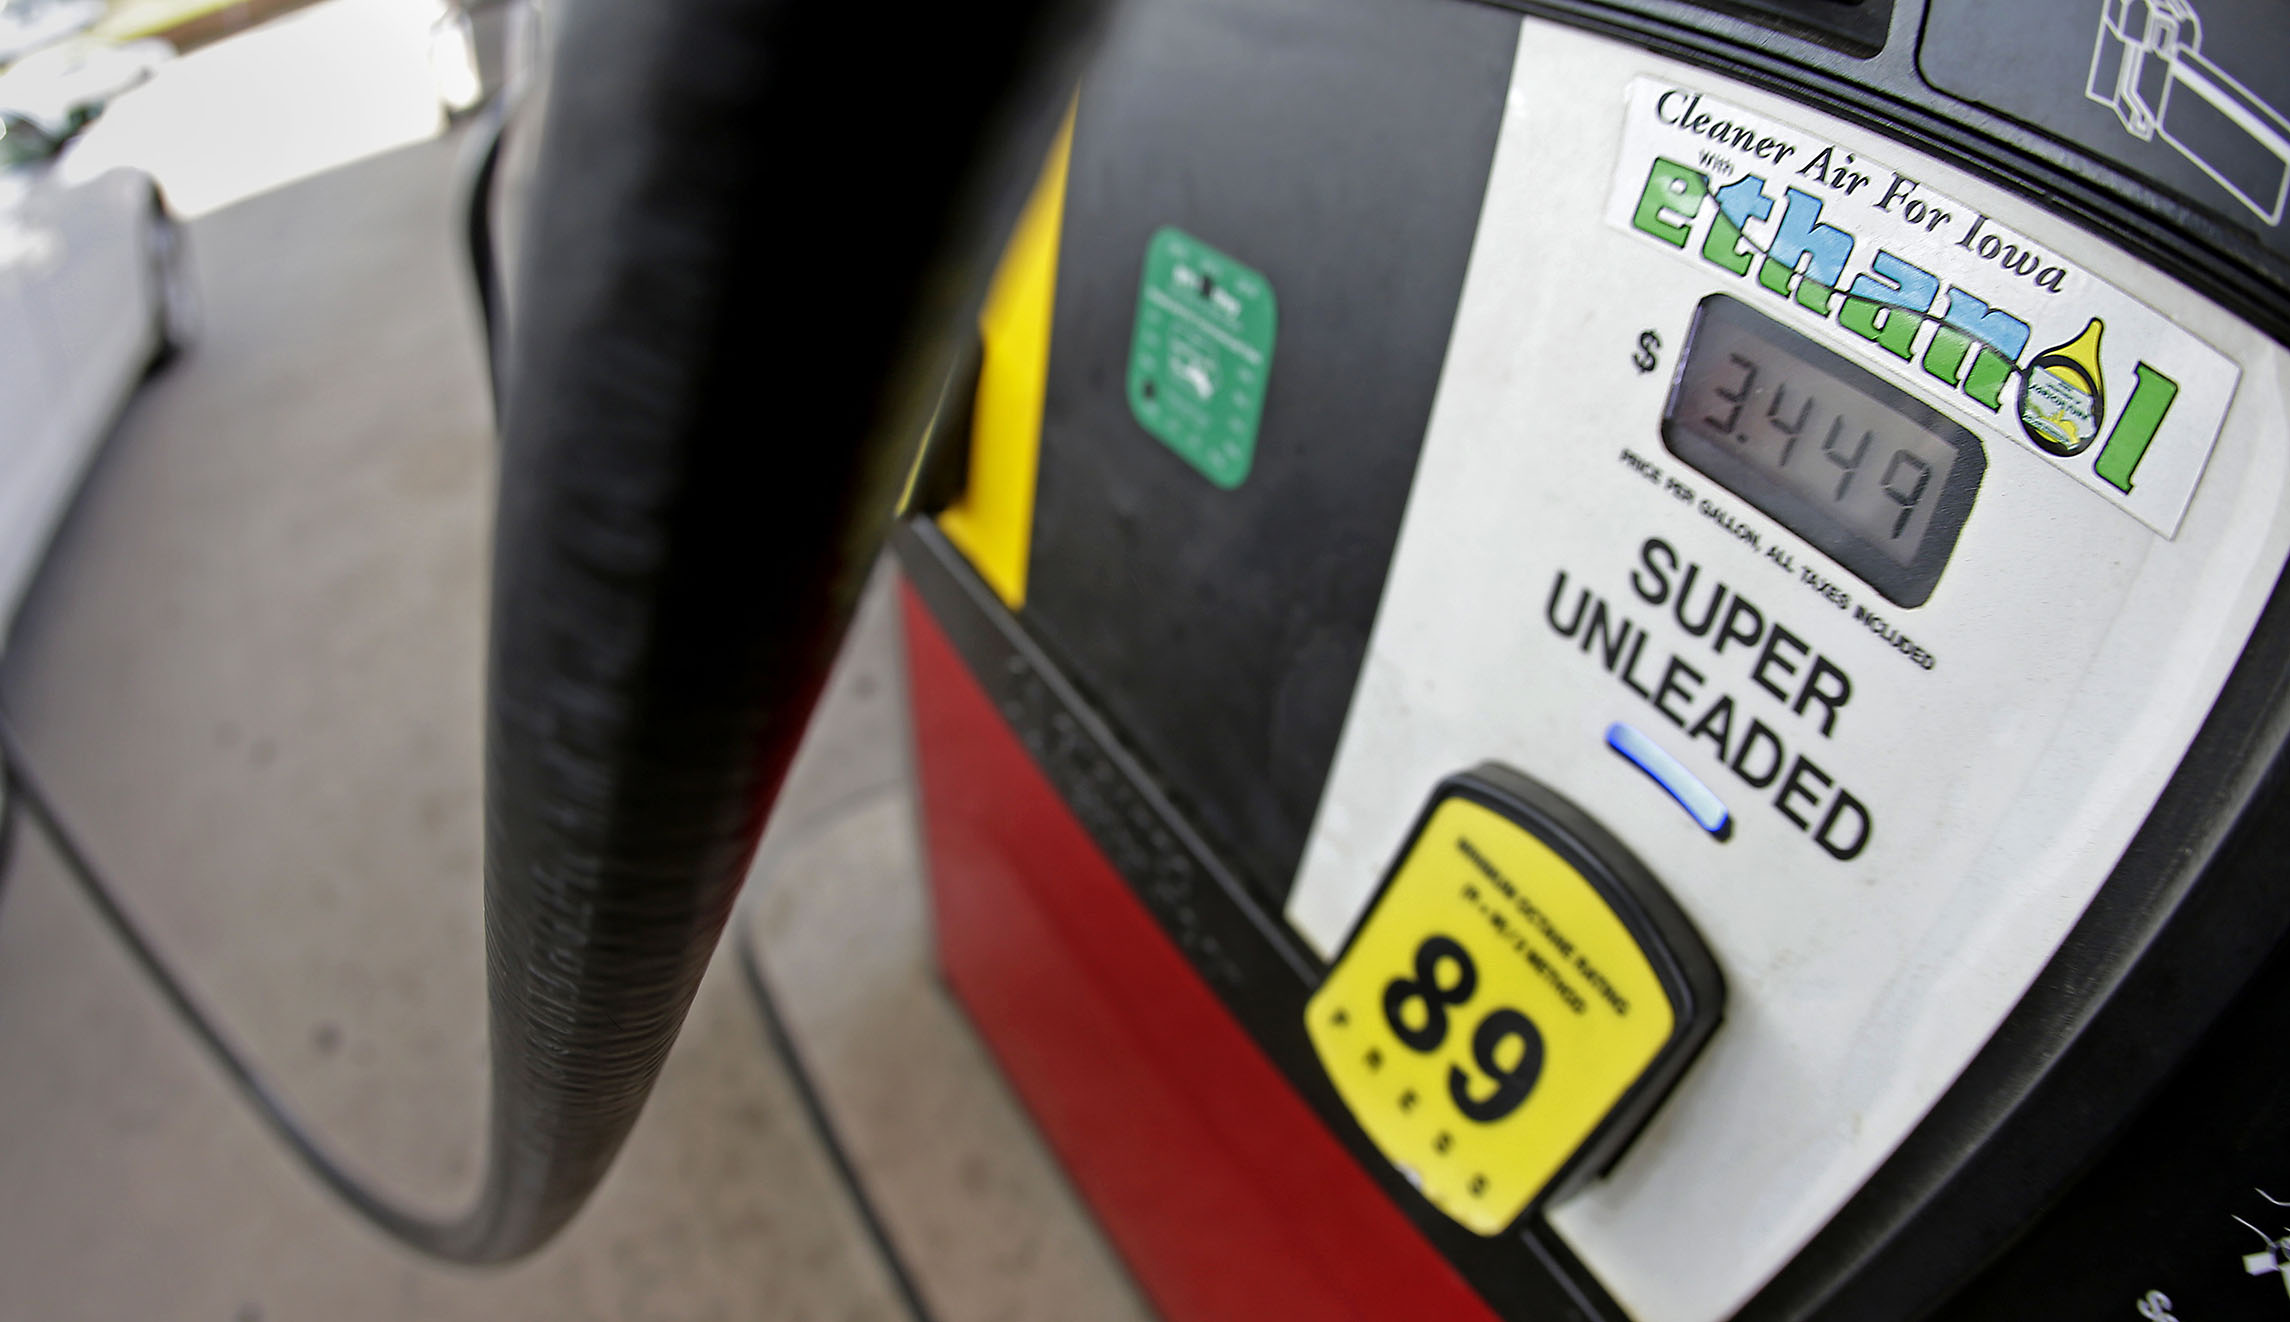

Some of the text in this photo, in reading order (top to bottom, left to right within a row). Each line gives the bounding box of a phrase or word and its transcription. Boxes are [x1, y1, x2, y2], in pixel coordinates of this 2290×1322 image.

[1656, 88, 2068, 294] Cleaner Air For Iowa
[1632, 156, 2178, 495] ethanol
[1632, 329, 1662, 374] $
[1703, 352, 1931, 540] 3.449
[1619, 448, 1662, 485] PRICE
[1664, 477, 1696, 505] PER
[1765, 545, 1795, 574] ALL
[1800, 565, 1850, 610] TAXES
[1852, 604, 1935, 671] INCLUDED
[1629, 537, 1855, 739] SUPER
[1545, 570, 1874, 863] UNLEADED
[1382, 934, 1546, 1125] 89
